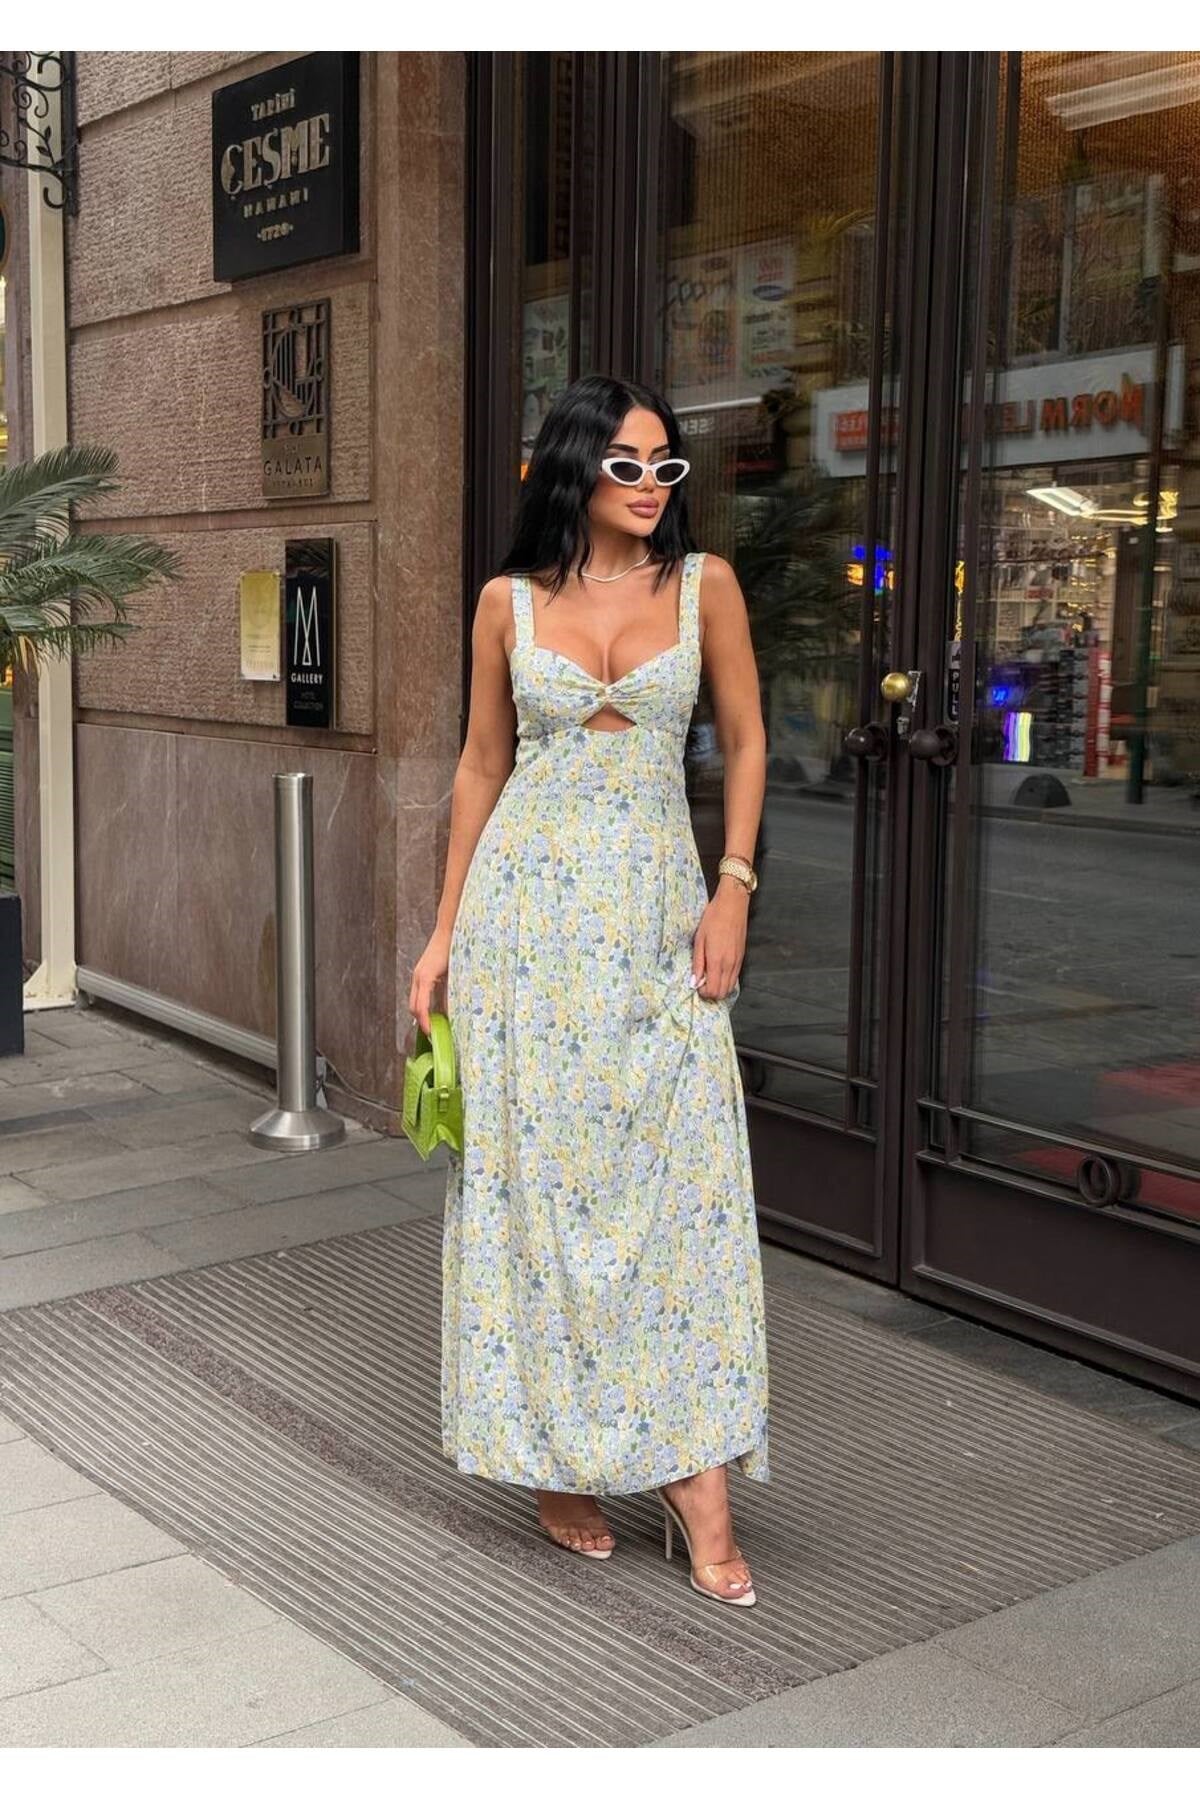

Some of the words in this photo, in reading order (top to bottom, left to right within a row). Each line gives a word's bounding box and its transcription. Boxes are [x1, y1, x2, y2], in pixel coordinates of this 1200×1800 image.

[220, 112, 330, 200] ÇEŞME
[263, 456, 322, 476] GALATA
[290, 672, 324, 686] GALLERY
[951, 671, 960, 715] PULL
